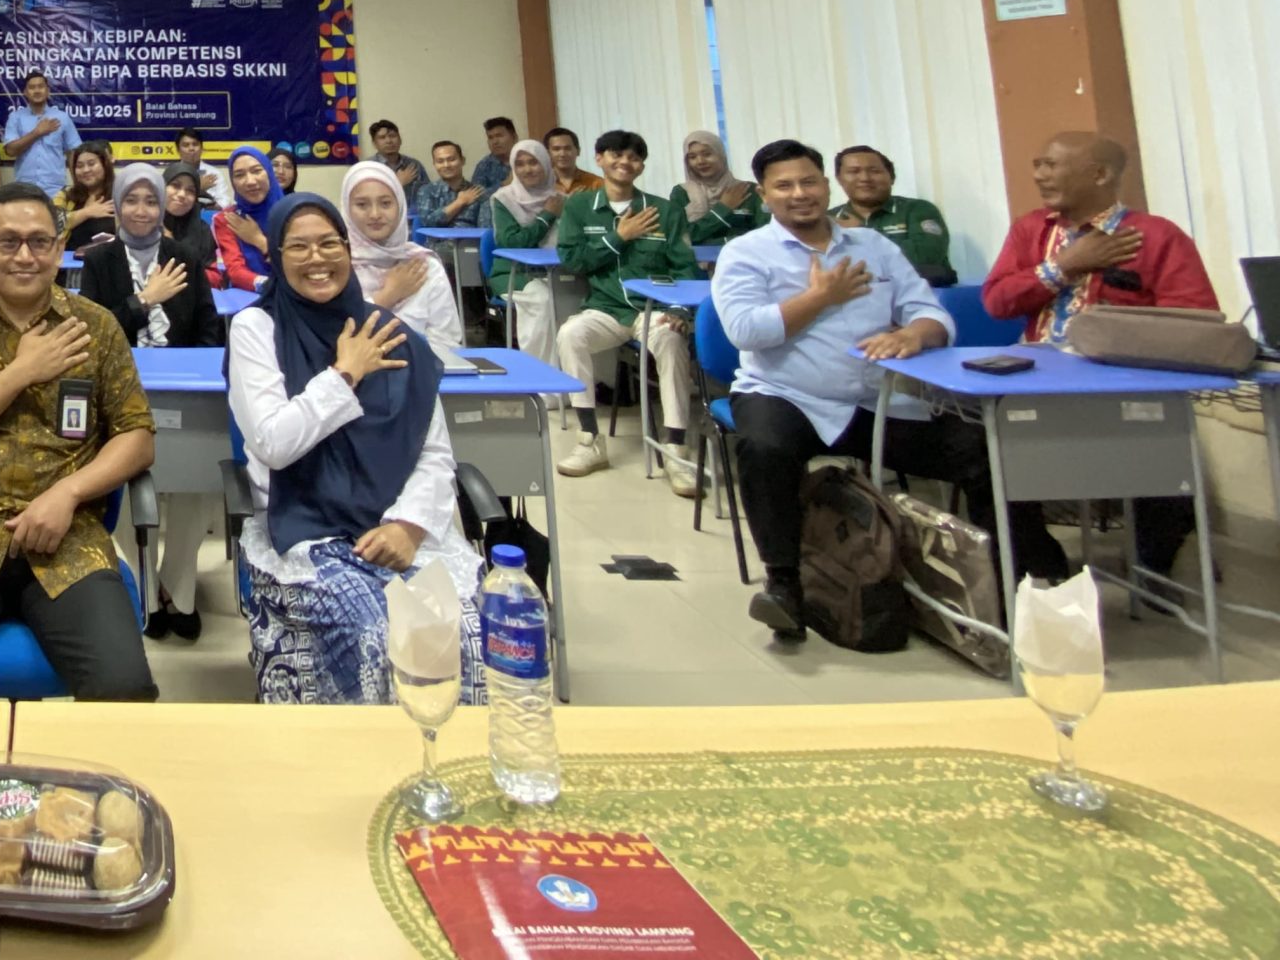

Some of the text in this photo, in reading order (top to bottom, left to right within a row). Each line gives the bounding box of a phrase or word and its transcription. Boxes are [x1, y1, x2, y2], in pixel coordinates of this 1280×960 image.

[94, 29, 187, 43] KEBIPAAN:
[125, 46, 241, 60] KOMPETENSI
[91, 65, 132, 78] BIPA
[137, 64, 226, 78] BERBASIS
[232, 63, 287, 77] SKKNI
[95, 104, 132, 118] 2025
[145, 102, 198, 110] Balai Bahasa
[145, 111, 217, 120] Provinsi Lampung
[527, 925, 578, 935] BAHASA
[577, 925, 634, 936] PROVINSI
[634, 927, 695, 937] LAMPUNG
